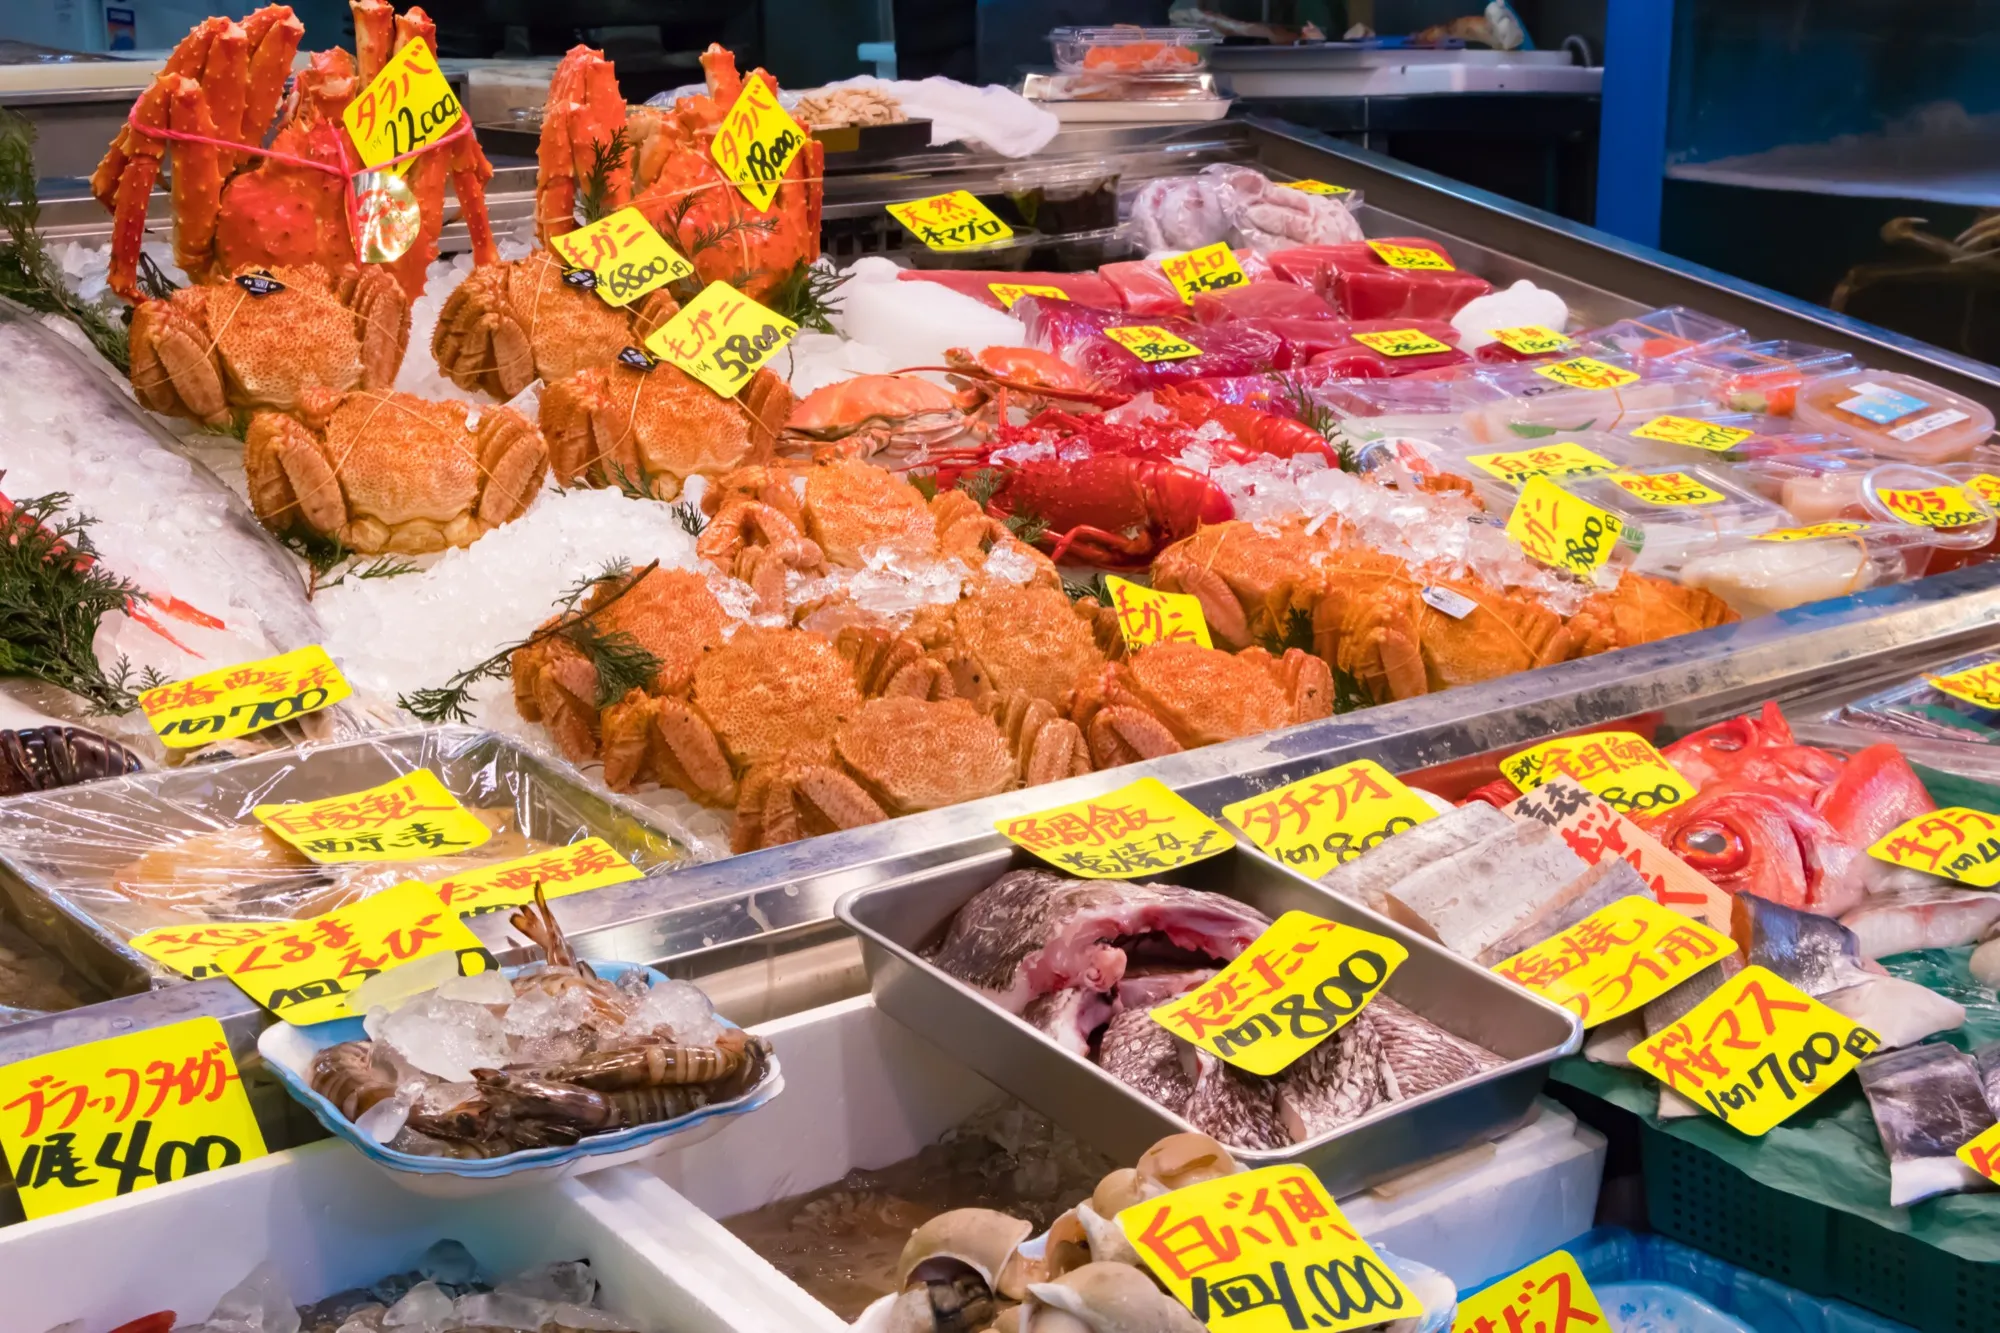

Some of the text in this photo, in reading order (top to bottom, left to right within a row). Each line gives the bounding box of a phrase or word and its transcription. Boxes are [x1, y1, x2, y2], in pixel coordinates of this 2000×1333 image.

[357, 44, 433, 141] タラバ
[721, 84, 771, 170] タラバ
[896, 191, 978, 229] 天然
[920, 217, 1001, 246] 本マグロ
[564, 221, 645, 270] 毛ガニ
[1168, 250, 1225, 282] 中トロ
[663, 301, 745, 361] 毛ガニ
[1888, 491, 1946, 513] イクラ
[1116, 585, 1197, 642] 毛ガニ
[1536, 736, 1670, 782] 金目鯛
[265, 786, 458, 836] 自家製
[1007, 803, 1176, 852] 鯛飯
[1241, 767, 1393, 847] タチウオ
[1513, 781, 1595, 827] 青森
[1886, 811, 1997, 872] 生タラ
[234, 918, 354, 975] くるま
[336, 913, 443, 980] えび
[1559, 925, 1719, 1021] フライ用
[1167, 922, 1337, 1040] 天然たい
[1646, 980, 1812, 1089] 桜マス
[1137, 1175, 1357, 1281] 白バイ貝
